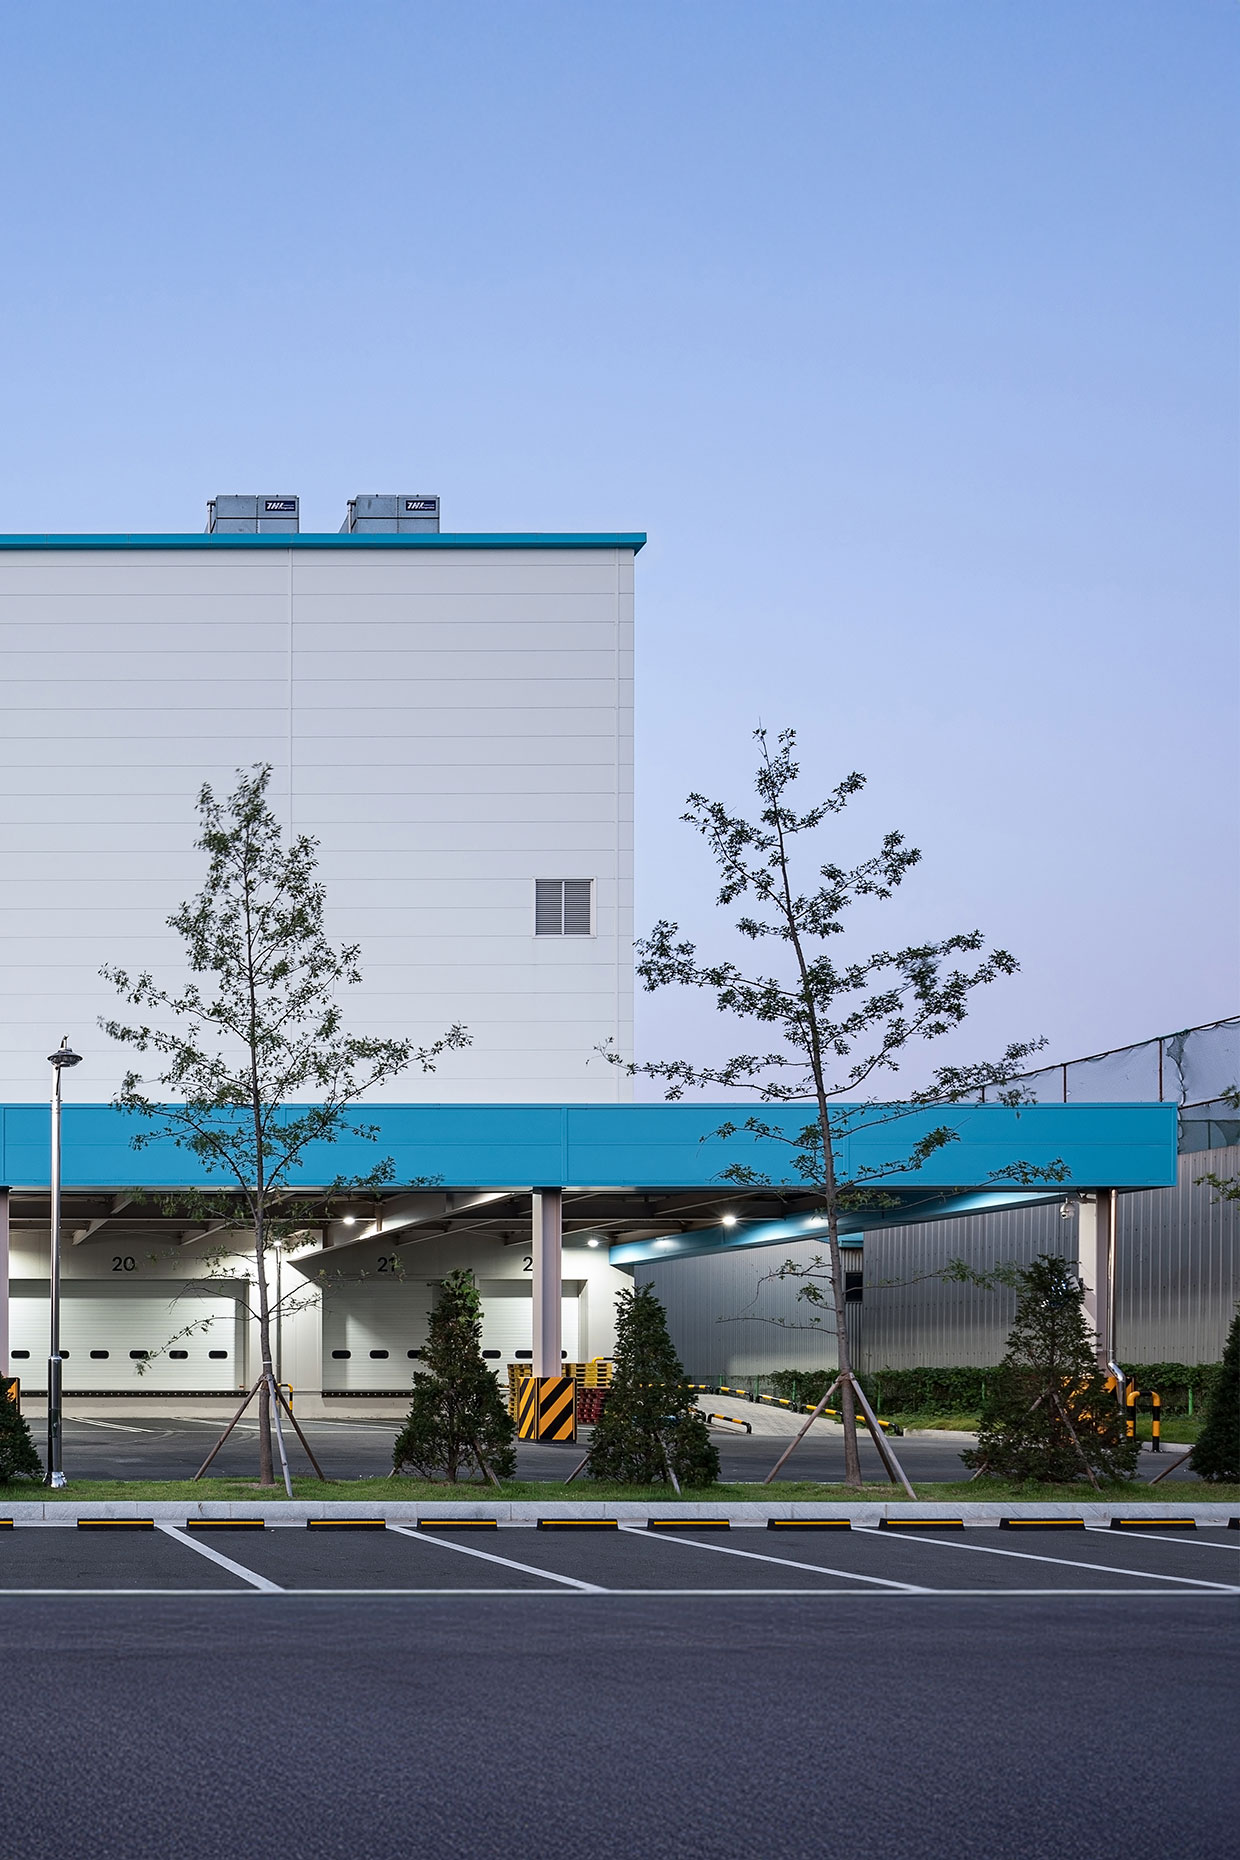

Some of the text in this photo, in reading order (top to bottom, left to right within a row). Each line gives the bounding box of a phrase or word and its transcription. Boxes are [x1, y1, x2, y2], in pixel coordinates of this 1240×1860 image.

[112, 1256, 136, 1272] 20
[377, 1256, 395, 1272] 21
[523, 1256, 533, 1272] 2
